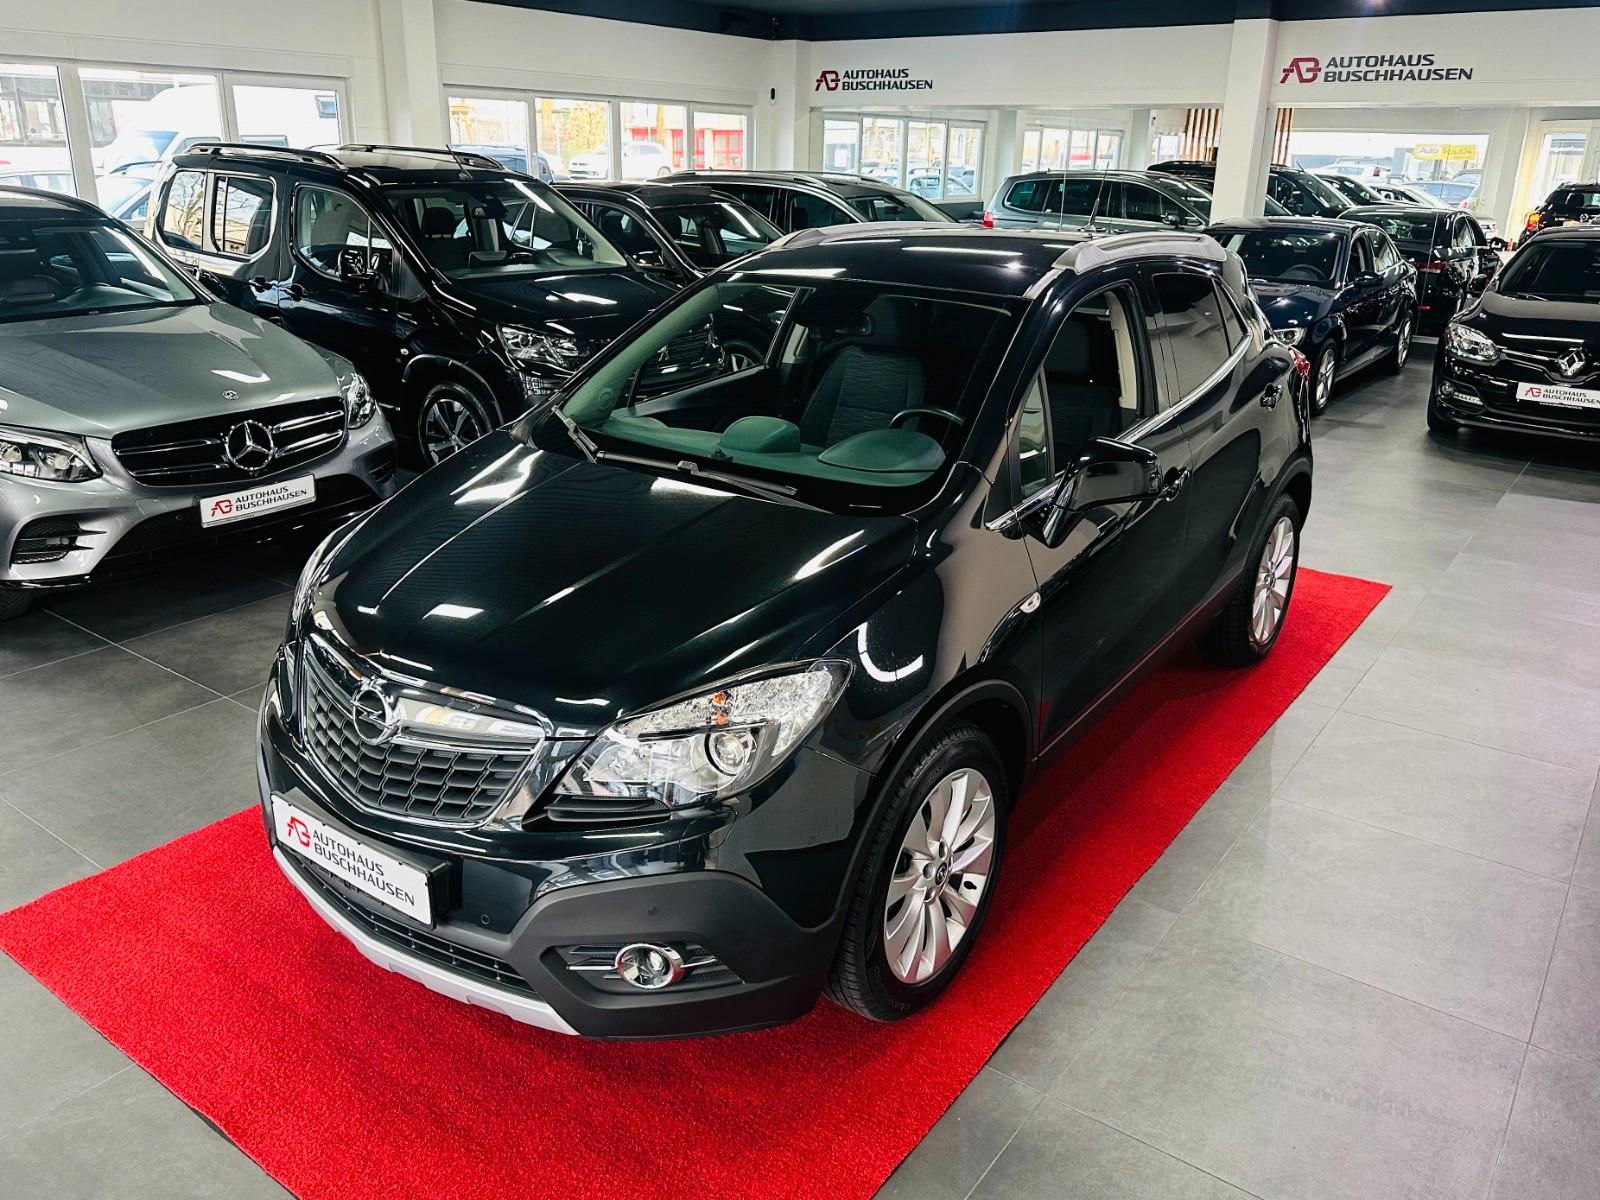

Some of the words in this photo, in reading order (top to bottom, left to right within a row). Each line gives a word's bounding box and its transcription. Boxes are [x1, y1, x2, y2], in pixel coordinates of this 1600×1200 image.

[1326, 54, 1435, 68] AUTOHAUS
[842, 68, 909, 80] AUTOHAUS
[1323, 68, 1474, 83] BUSCHHAUSEN
[842, 80, 933, 91] BUSCHHAUSEN
[1544, 389, 1587, 398] AUTOHAUS
[235, 486, 289, 503] AUTOHAUS
[235, 489, 307, 512] BUSCHHAUSEN
[312, 829, 384, 877] AUTOHAUS
[314, 843, 415, 906] BUSCHHAUSEN
